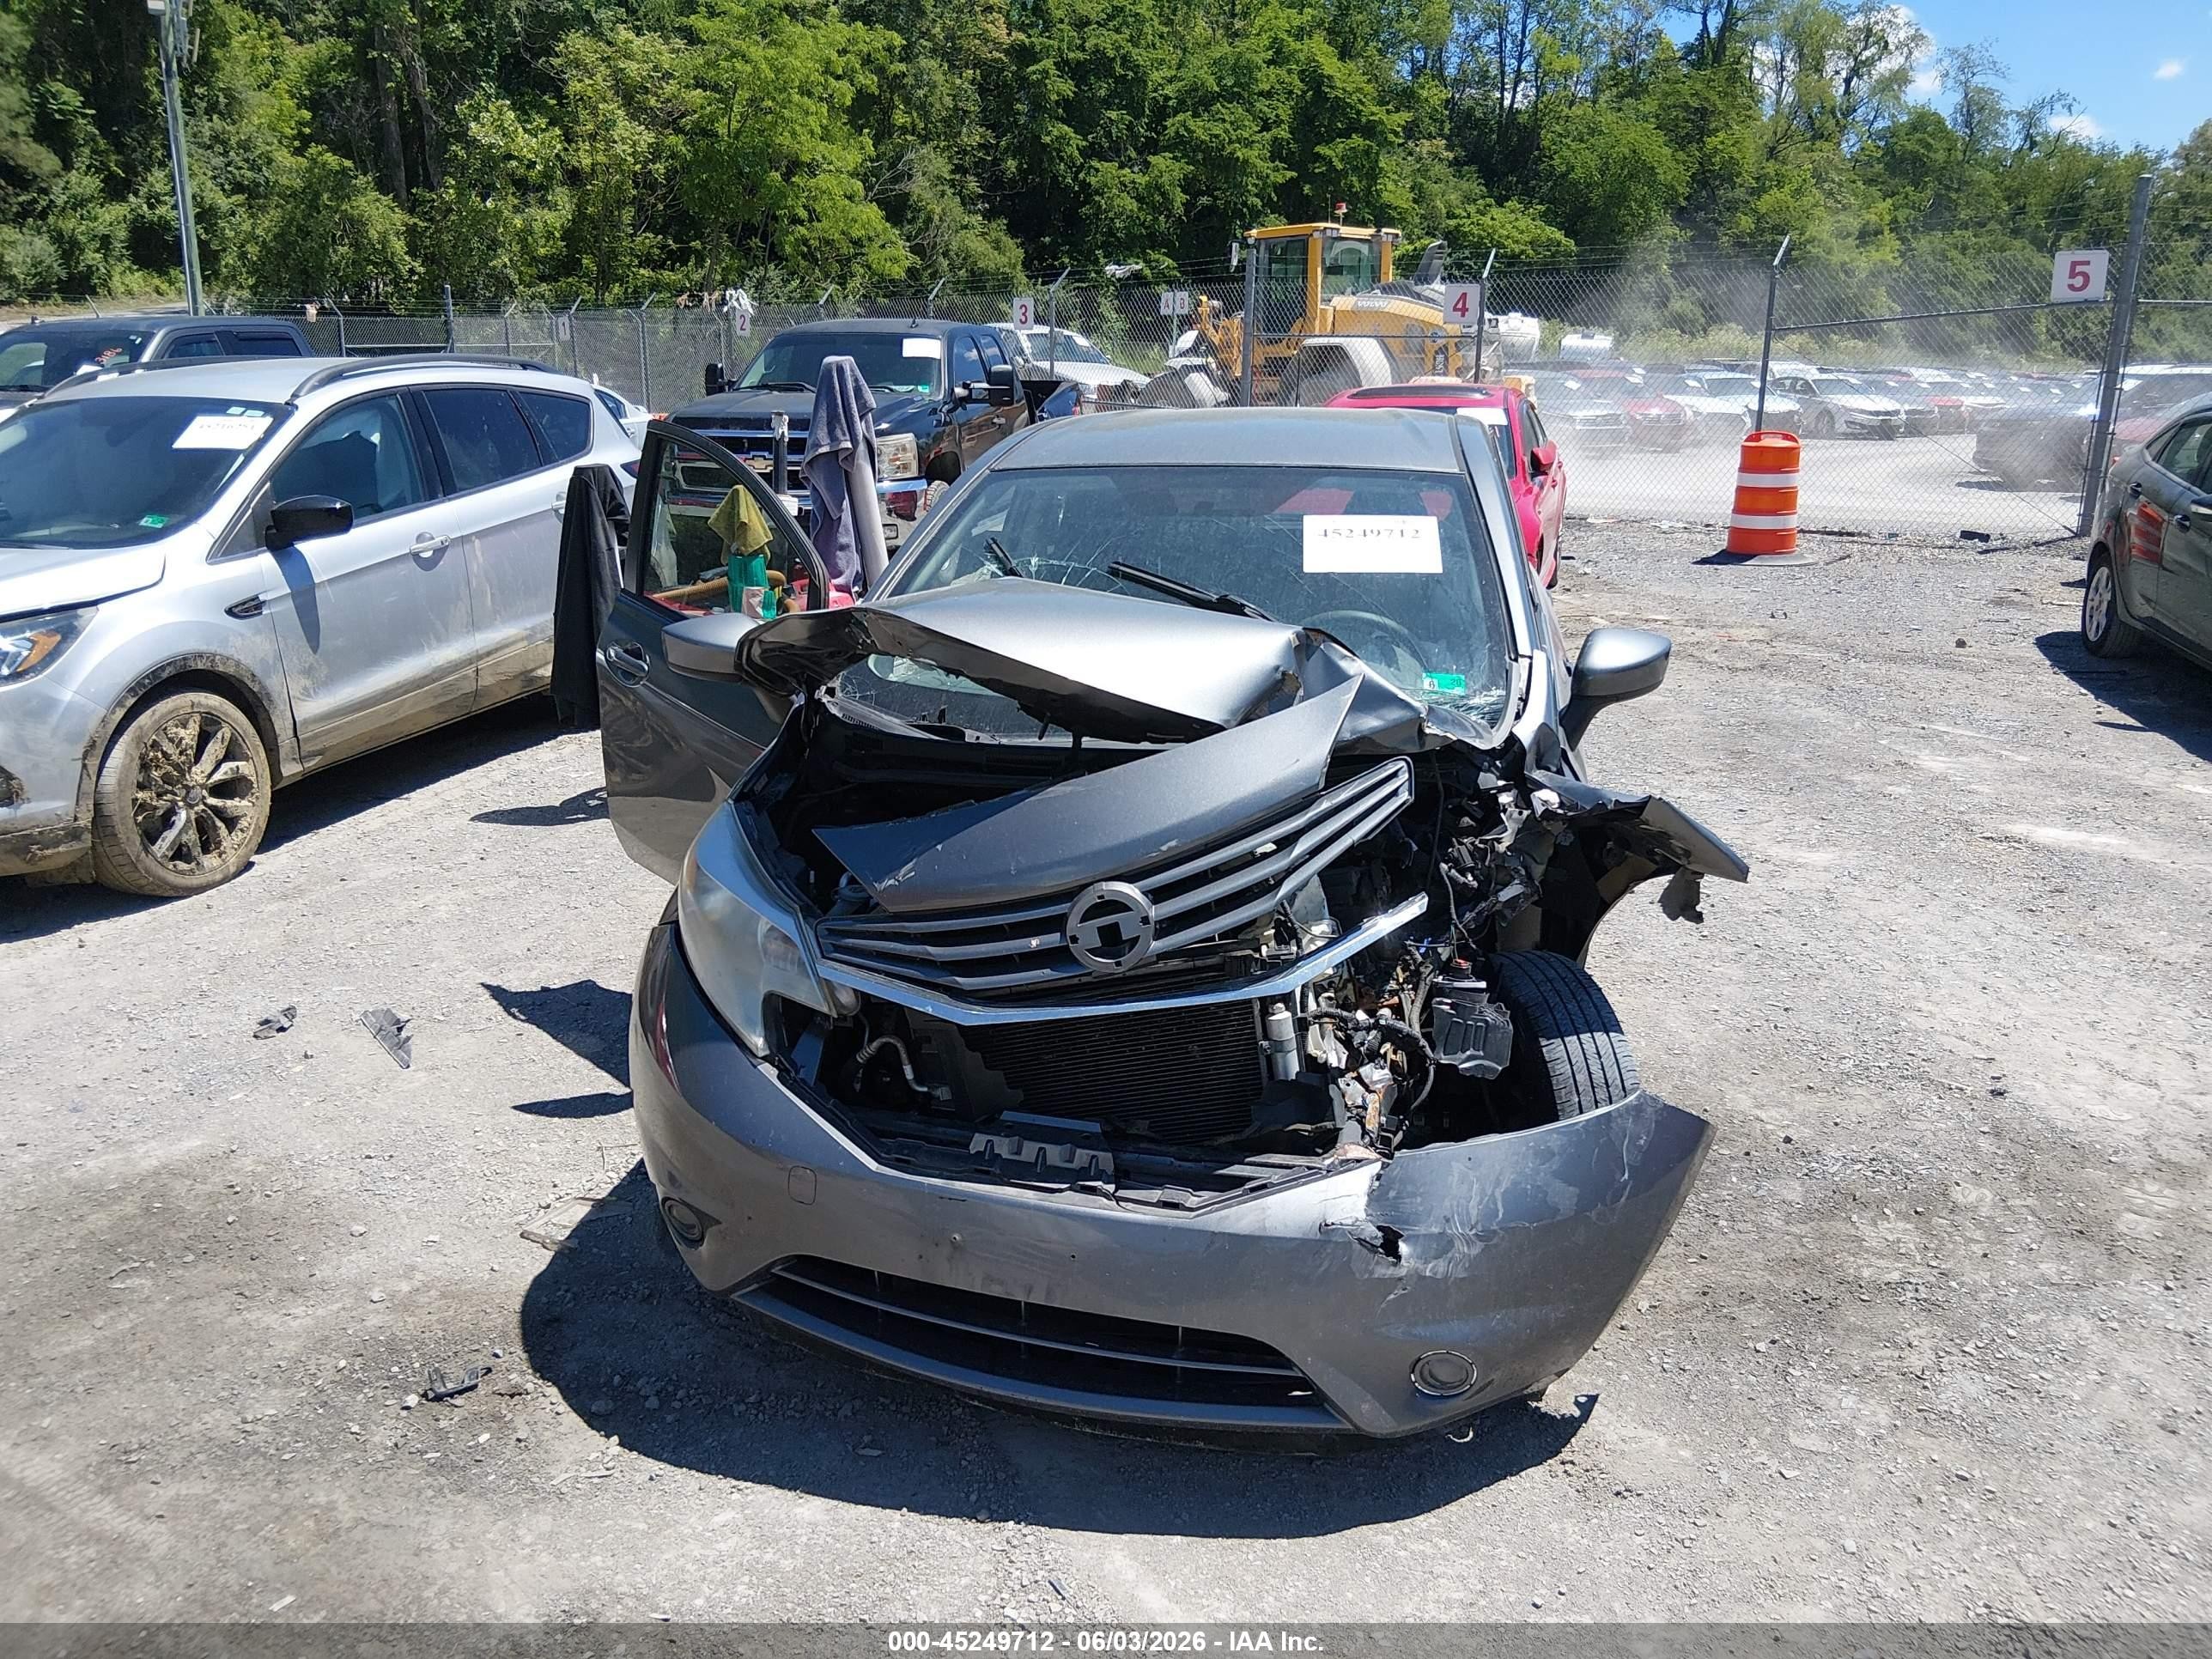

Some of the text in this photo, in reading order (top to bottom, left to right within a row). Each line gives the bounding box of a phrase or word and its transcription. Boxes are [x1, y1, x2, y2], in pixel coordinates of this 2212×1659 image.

[2067, 260, 2091, 292] 5
[1019, 303, 1028, 325] 3
[1452, 292, 1469, 318] 4
[562, 321, 567, 336] 1
[739, 314, 746, 331] 2
[1317, 528, 1422, 539] 45249712
